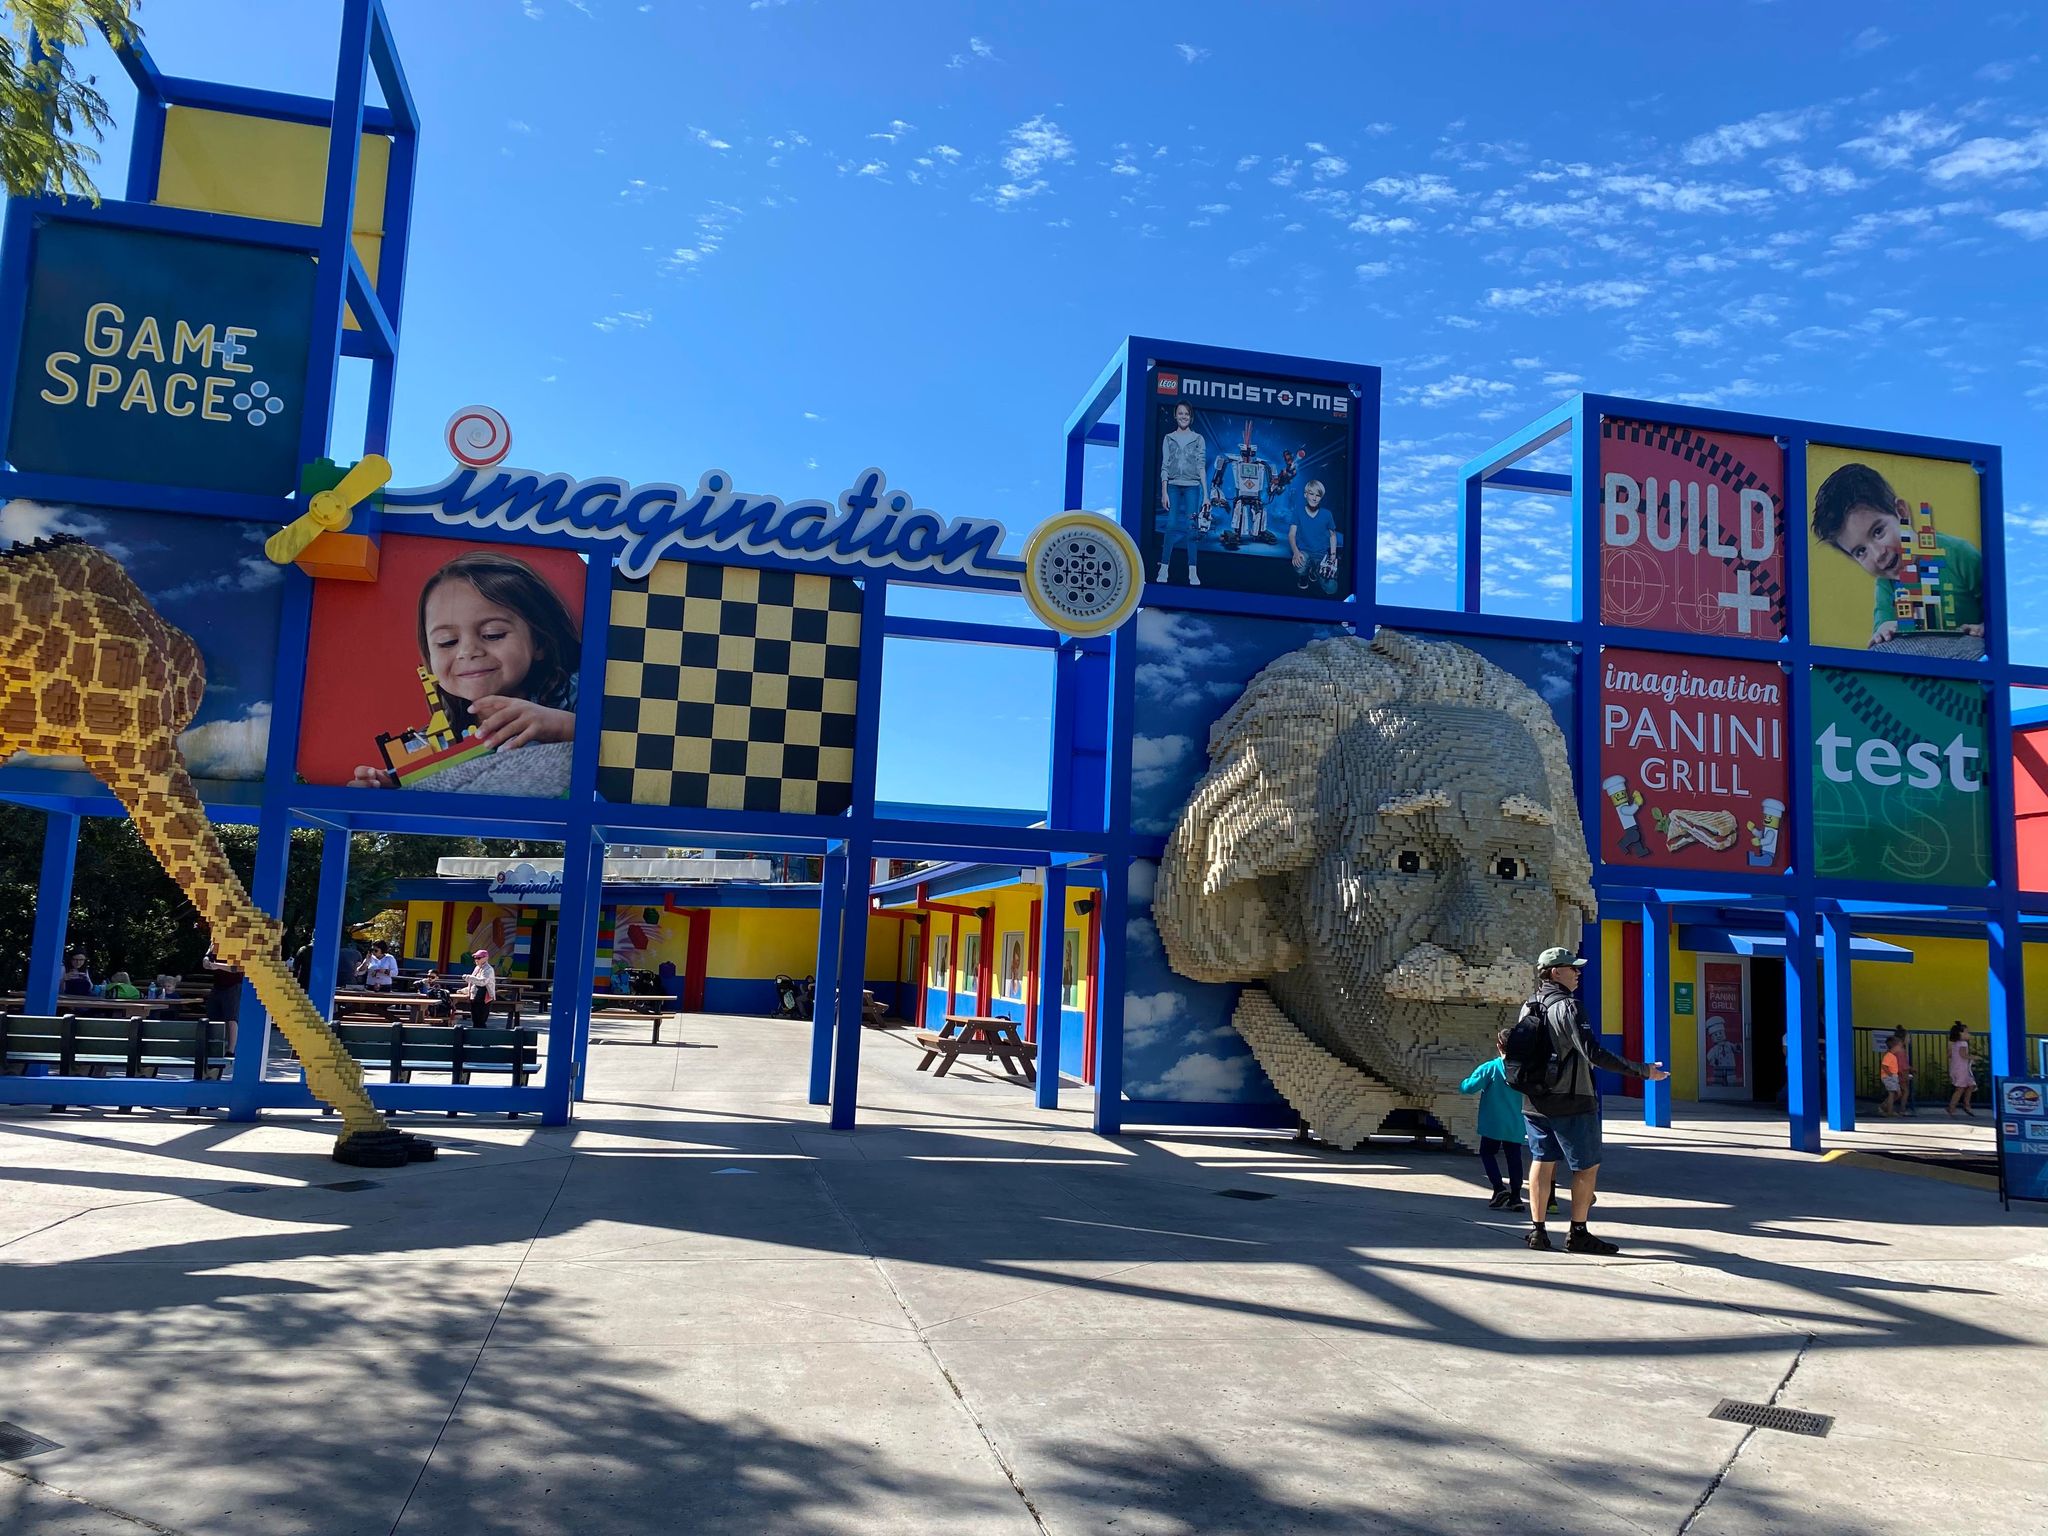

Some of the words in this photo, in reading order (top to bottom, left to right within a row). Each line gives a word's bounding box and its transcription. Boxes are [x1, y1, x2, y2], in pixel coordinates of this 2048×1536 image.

[84, 303, 257, 373] GAME
[41, 352, 236, 421] SPACE
[1158, 379, 1177, 389] LEGO
[418, 464, 1012, 577] imagination
[1604, 472, 1775, 562] BUILD
[1604, 663, 1780, 705] imagination
[1604, 704, 1782, 761] PANINI
[1815, 722, 1981, 792] test
[1640, 757, 1752, 798] GRILL
[1709, 992, 1736, 1001] PANINI
